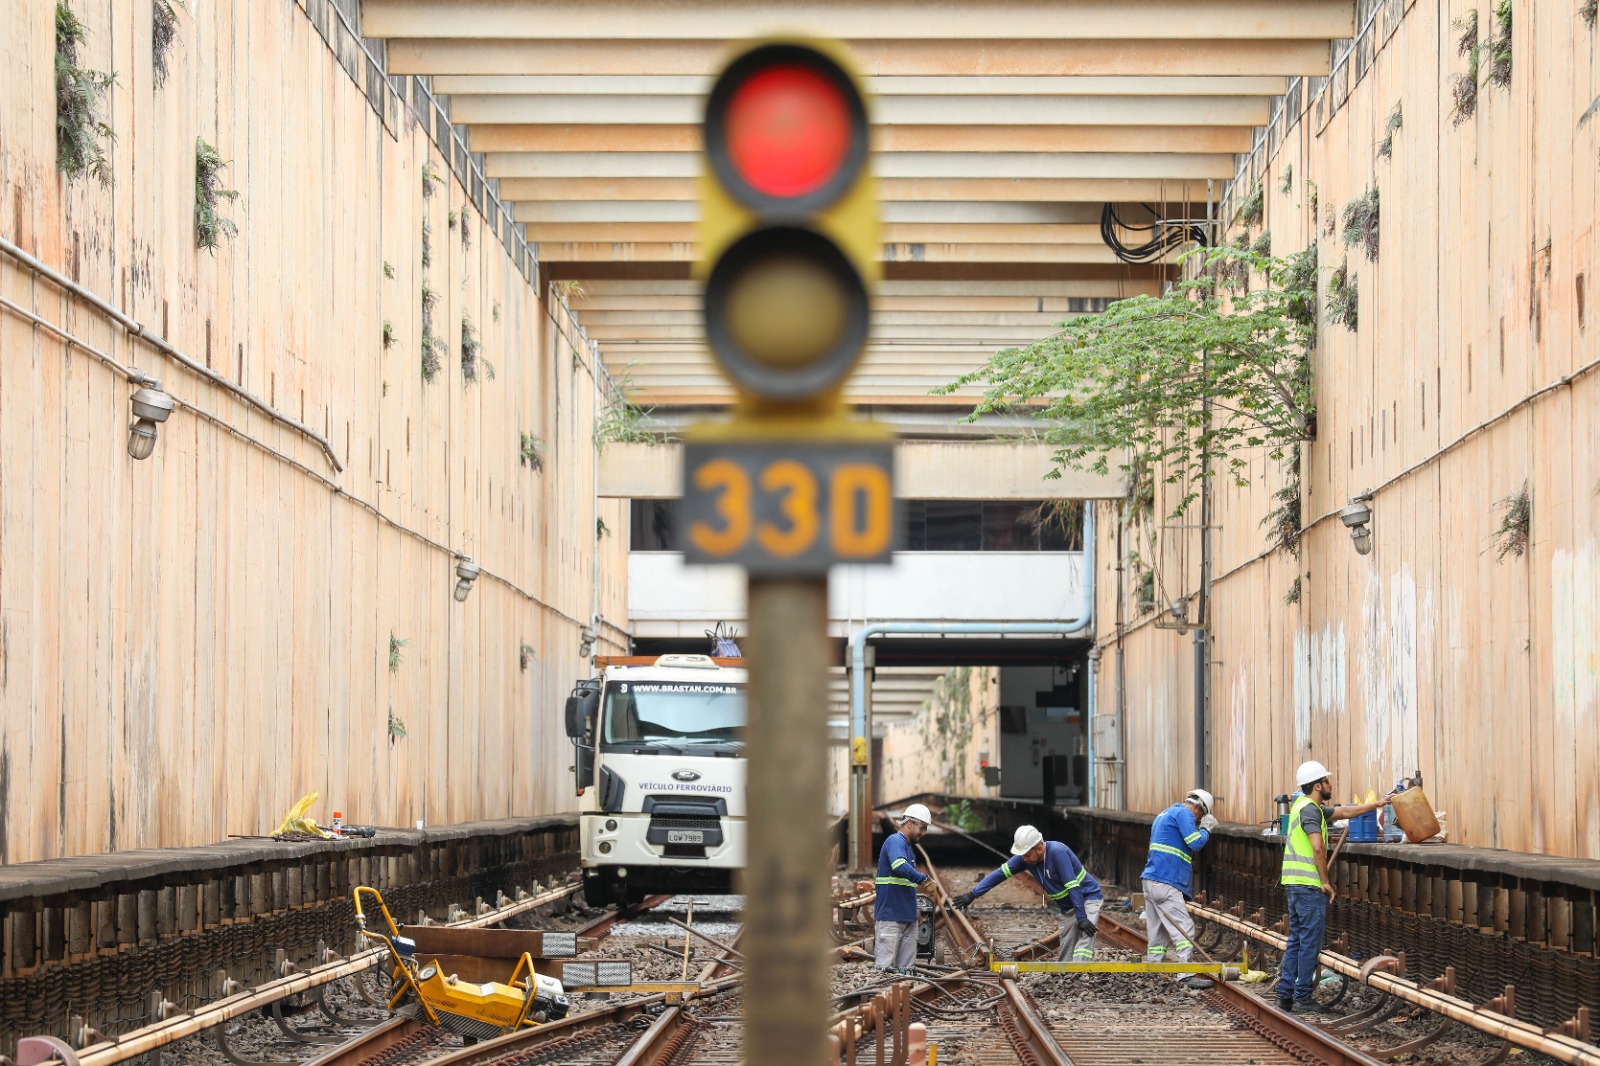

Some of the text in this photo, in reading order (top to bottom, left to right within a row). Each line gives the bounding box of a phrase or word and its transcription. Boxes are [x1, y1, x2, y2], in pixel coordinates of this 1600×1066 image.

[689, 459, 891, 558] 330
[633, 684, 737, 694] WWW.BRASTAN.COM.BR
[639, 782, 732, 793] VEÍCULO FERROVIÁRIO
